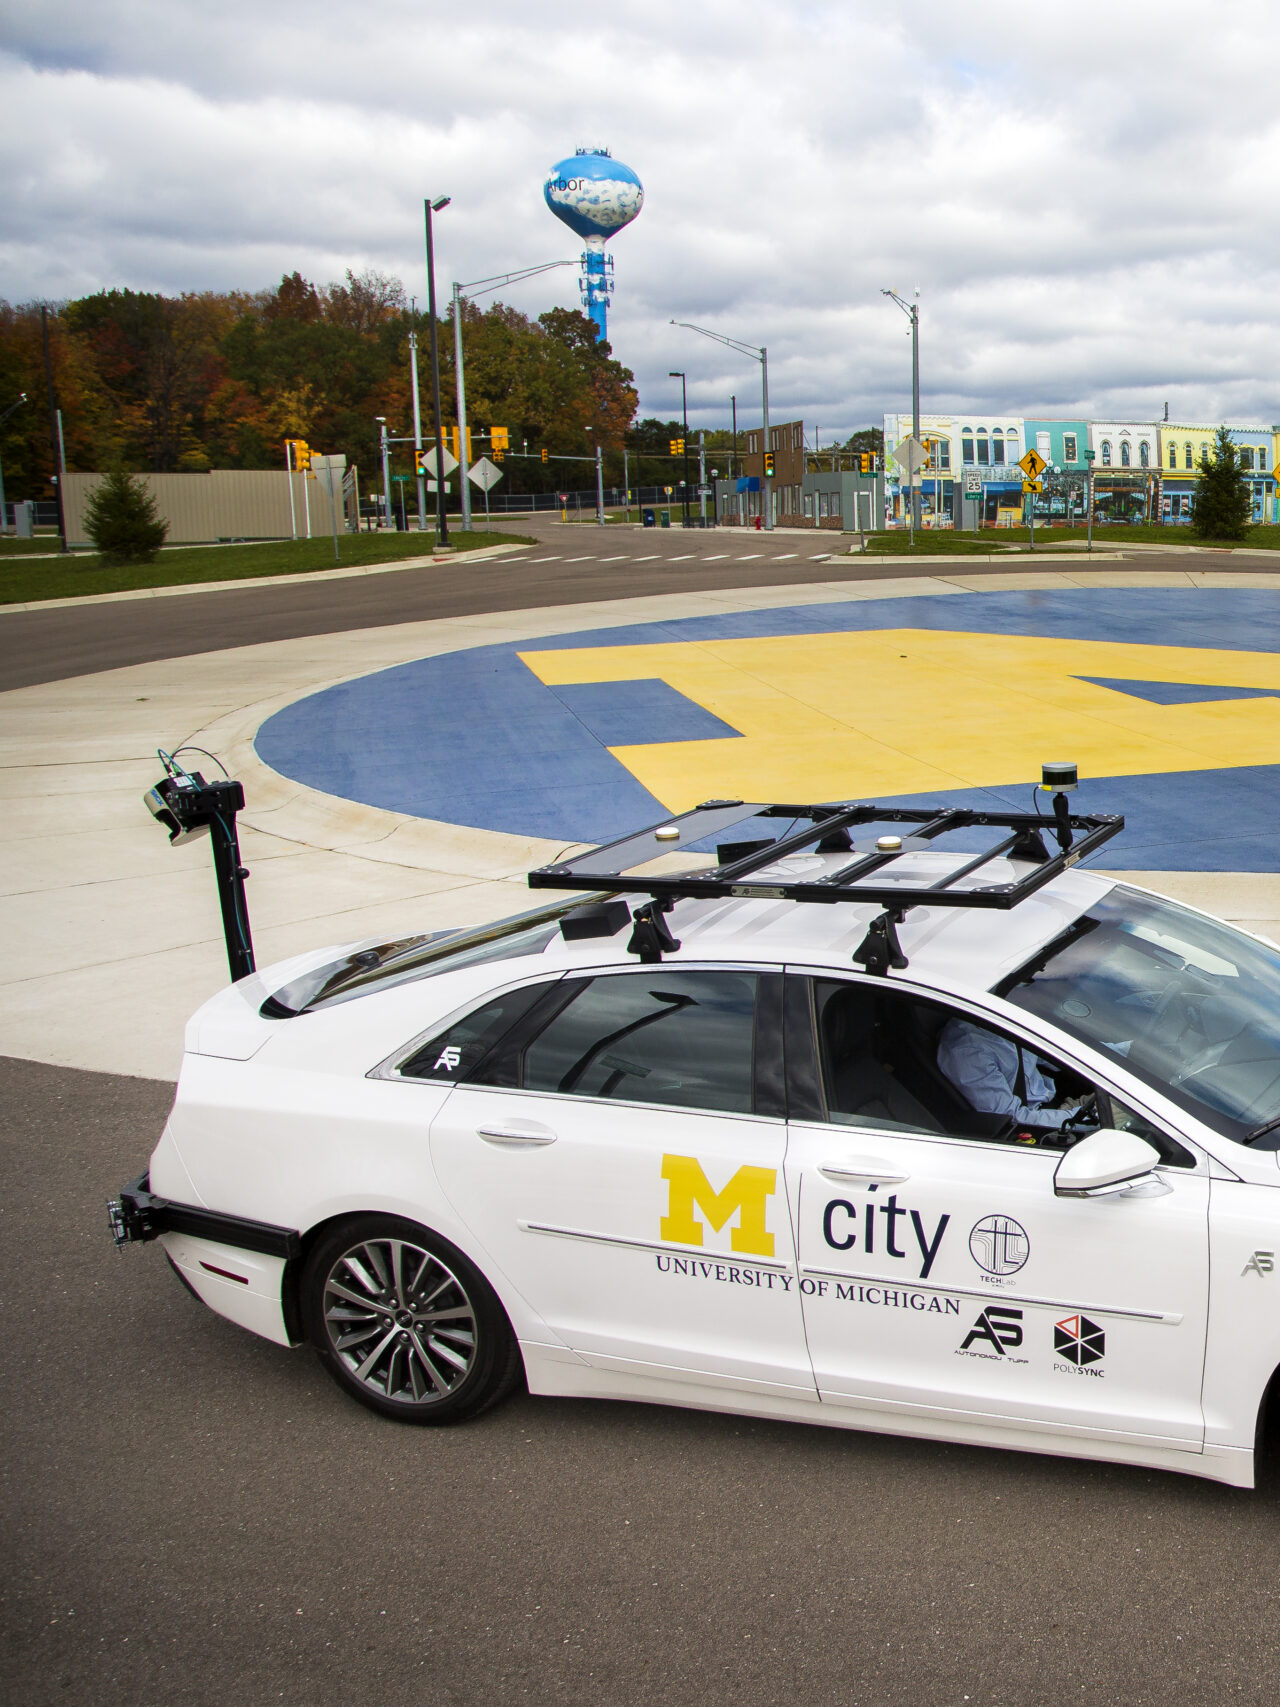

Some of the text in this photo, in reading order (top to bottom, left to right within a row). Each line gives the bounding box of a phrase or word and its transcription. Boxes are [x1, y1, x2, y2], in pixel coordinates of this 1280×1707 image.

[548, 177, 585, 193] Arbor
[968, 482, 981, 490] 25
[660, 1153, 951, 1279] M city
[656, 1255, 961, 1316] UNIVERSITY OF MICHIGAN
[1053, 1363, 1105, 1378] POLYSYNC
